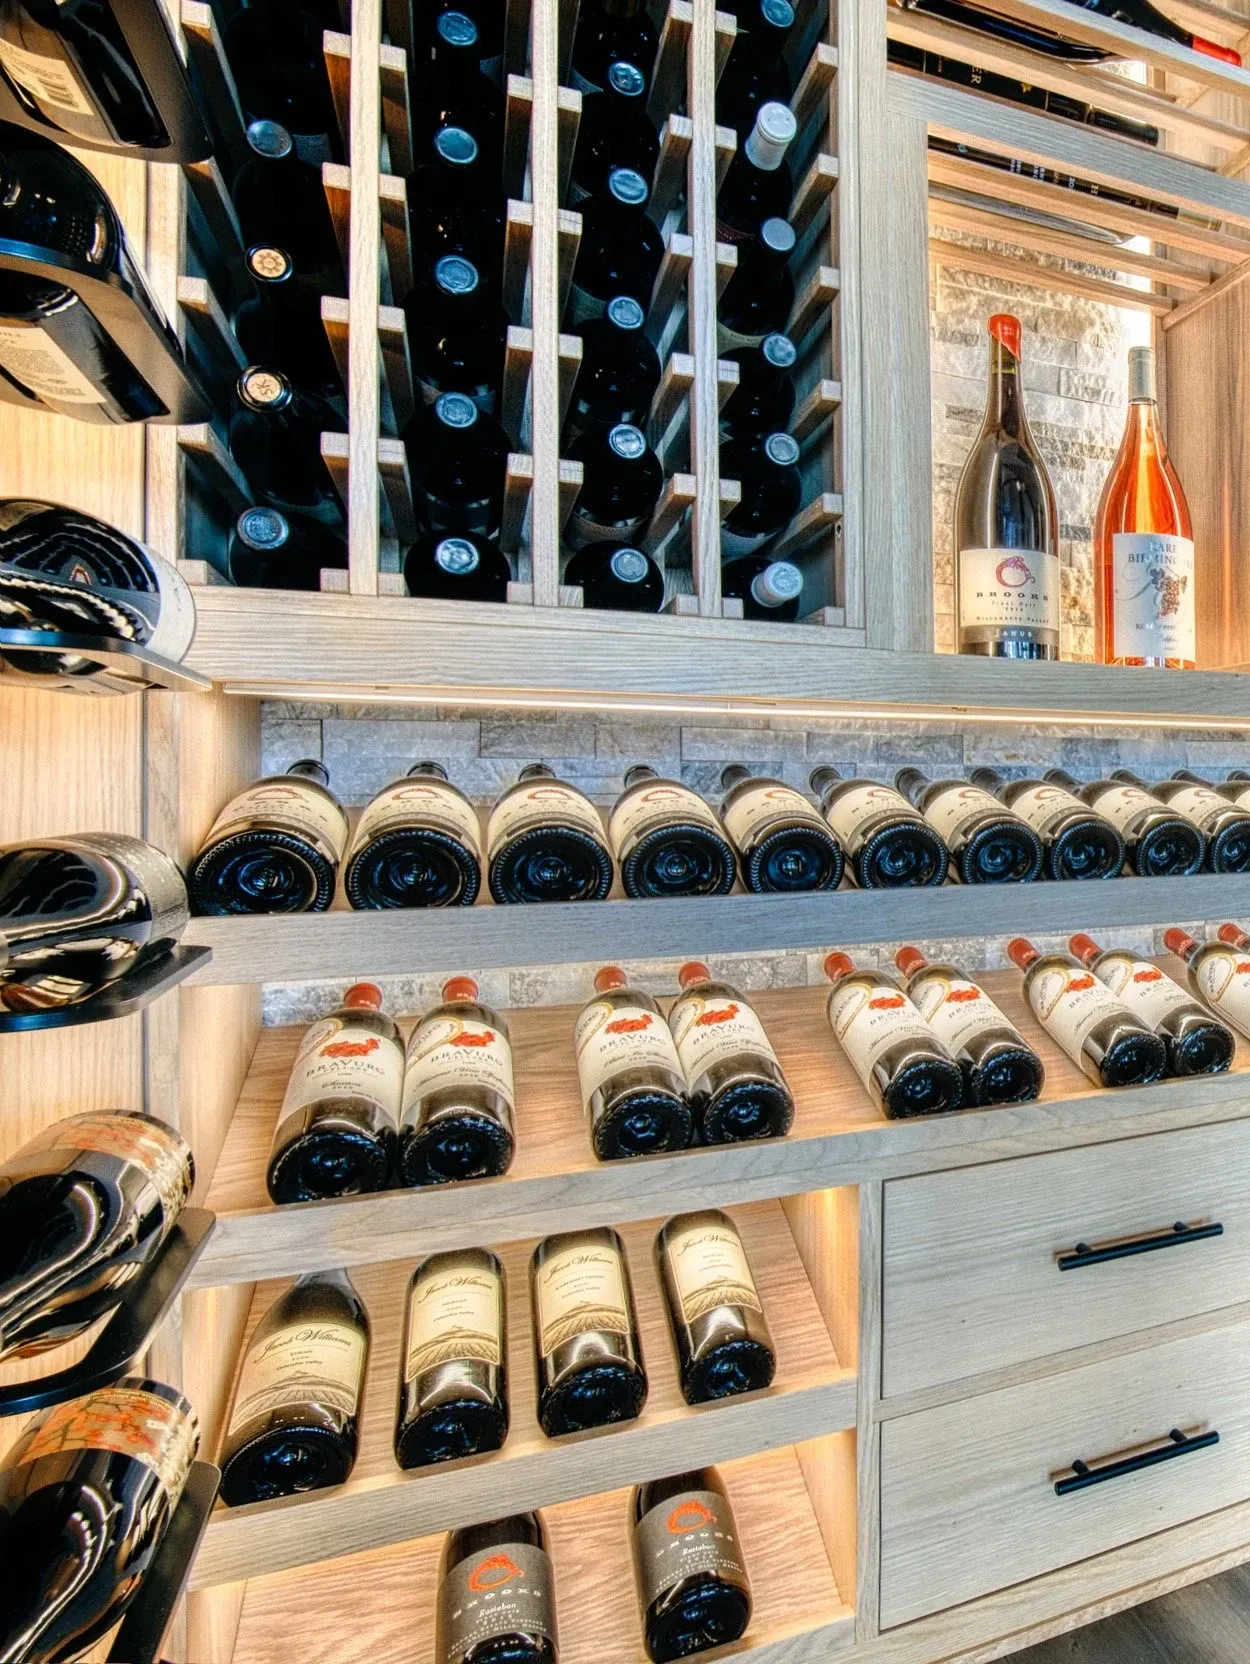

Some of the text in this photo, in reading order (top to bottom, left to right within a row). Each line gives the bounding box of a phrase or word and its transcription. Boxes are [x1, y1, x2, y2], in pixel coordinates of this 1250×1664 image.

[976, 591, 1048, 601] BROOKS
[995, 629, 1032, 638] JANUS
[430, 1048, 504, 1067] BRAVURO
[306, 1059, 386, 1078] BRAVURO
[449, 1276, 493, 1290] Williams
[253, 1328, 352, 1364] Jacob Williams
[453, 1587, 542, 1620] BROOKS
[479, 1602, 517, 1618] Rastaban
